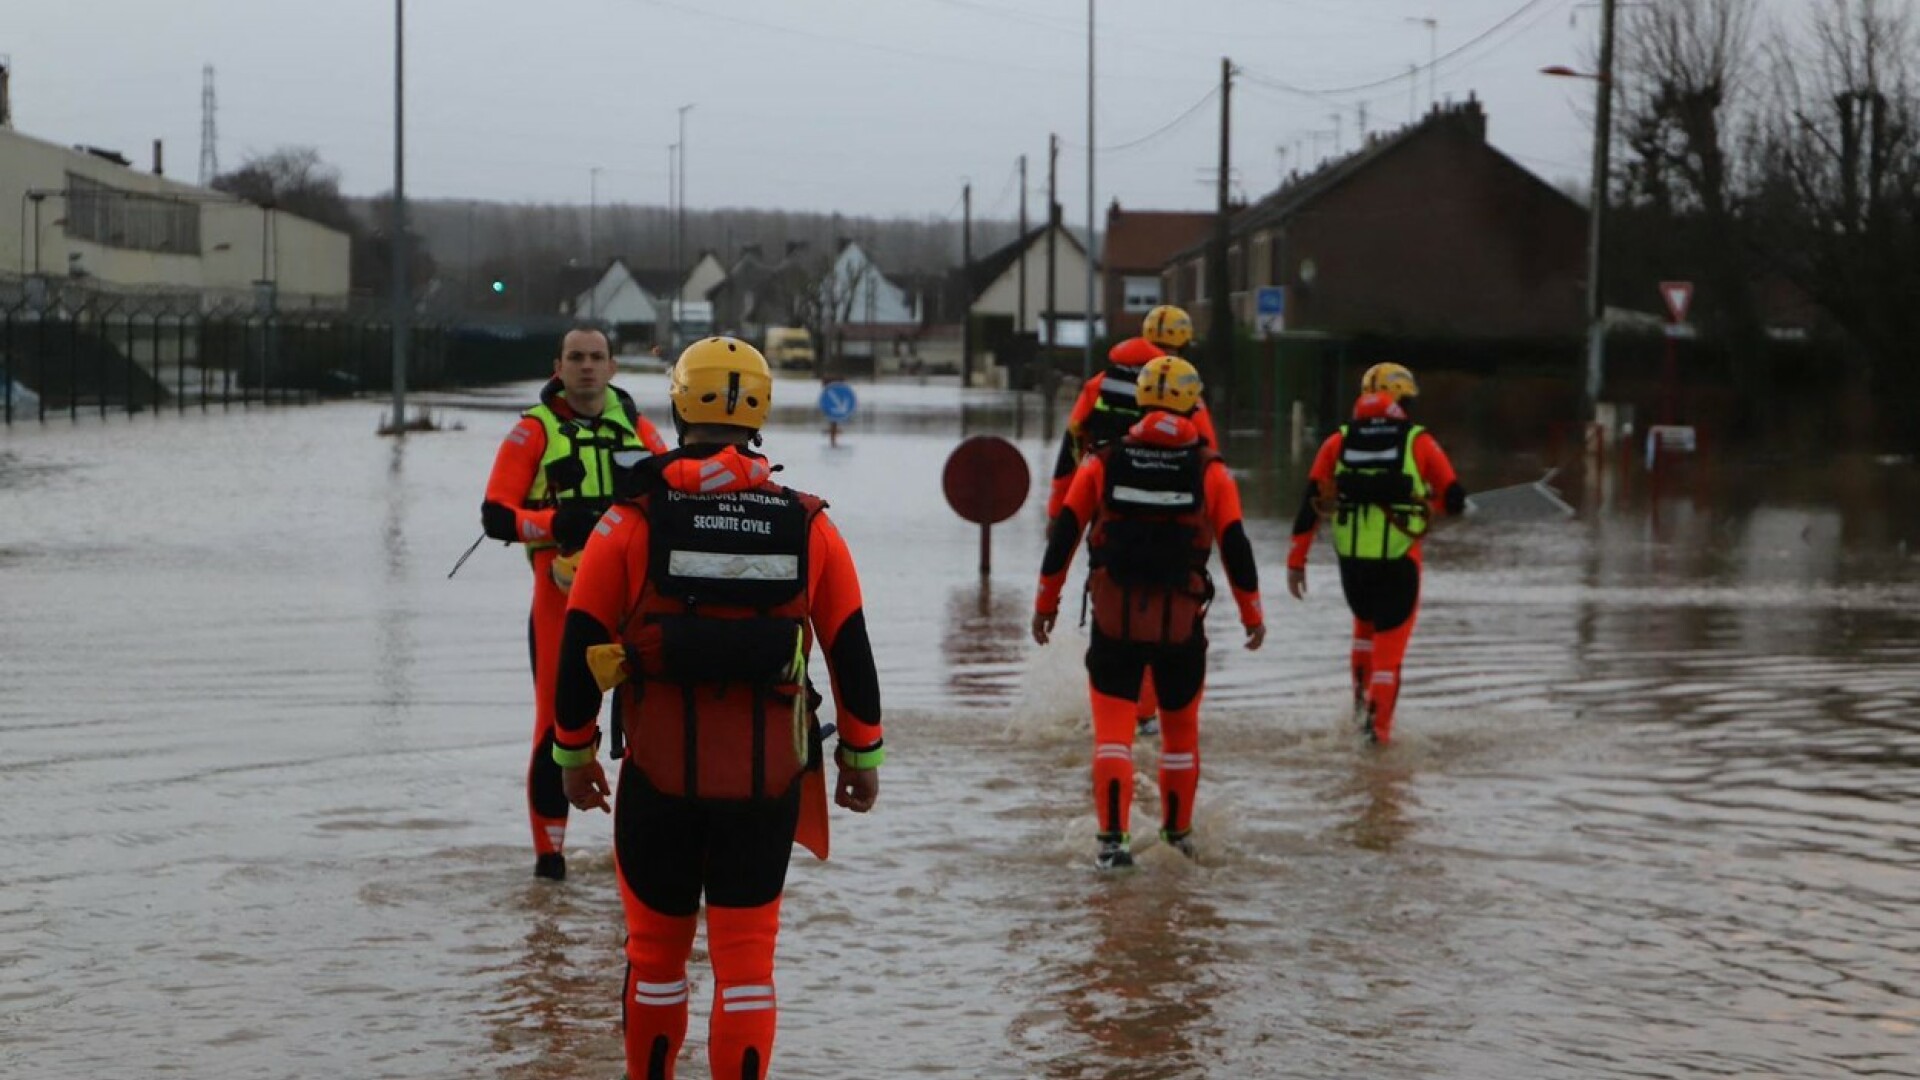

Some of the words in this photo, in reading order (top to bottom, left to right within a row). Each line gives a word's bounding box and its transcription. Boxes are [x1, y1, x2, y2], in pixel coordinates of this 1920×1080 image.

[740, 492, 788, 507] MILITAIRE
[719, 503, 730, 512] DE
[732, 504, 745, 513] LA
[694, 515, 739, 531] SECURITE
[742, 519, 771, 535] CIVILE
